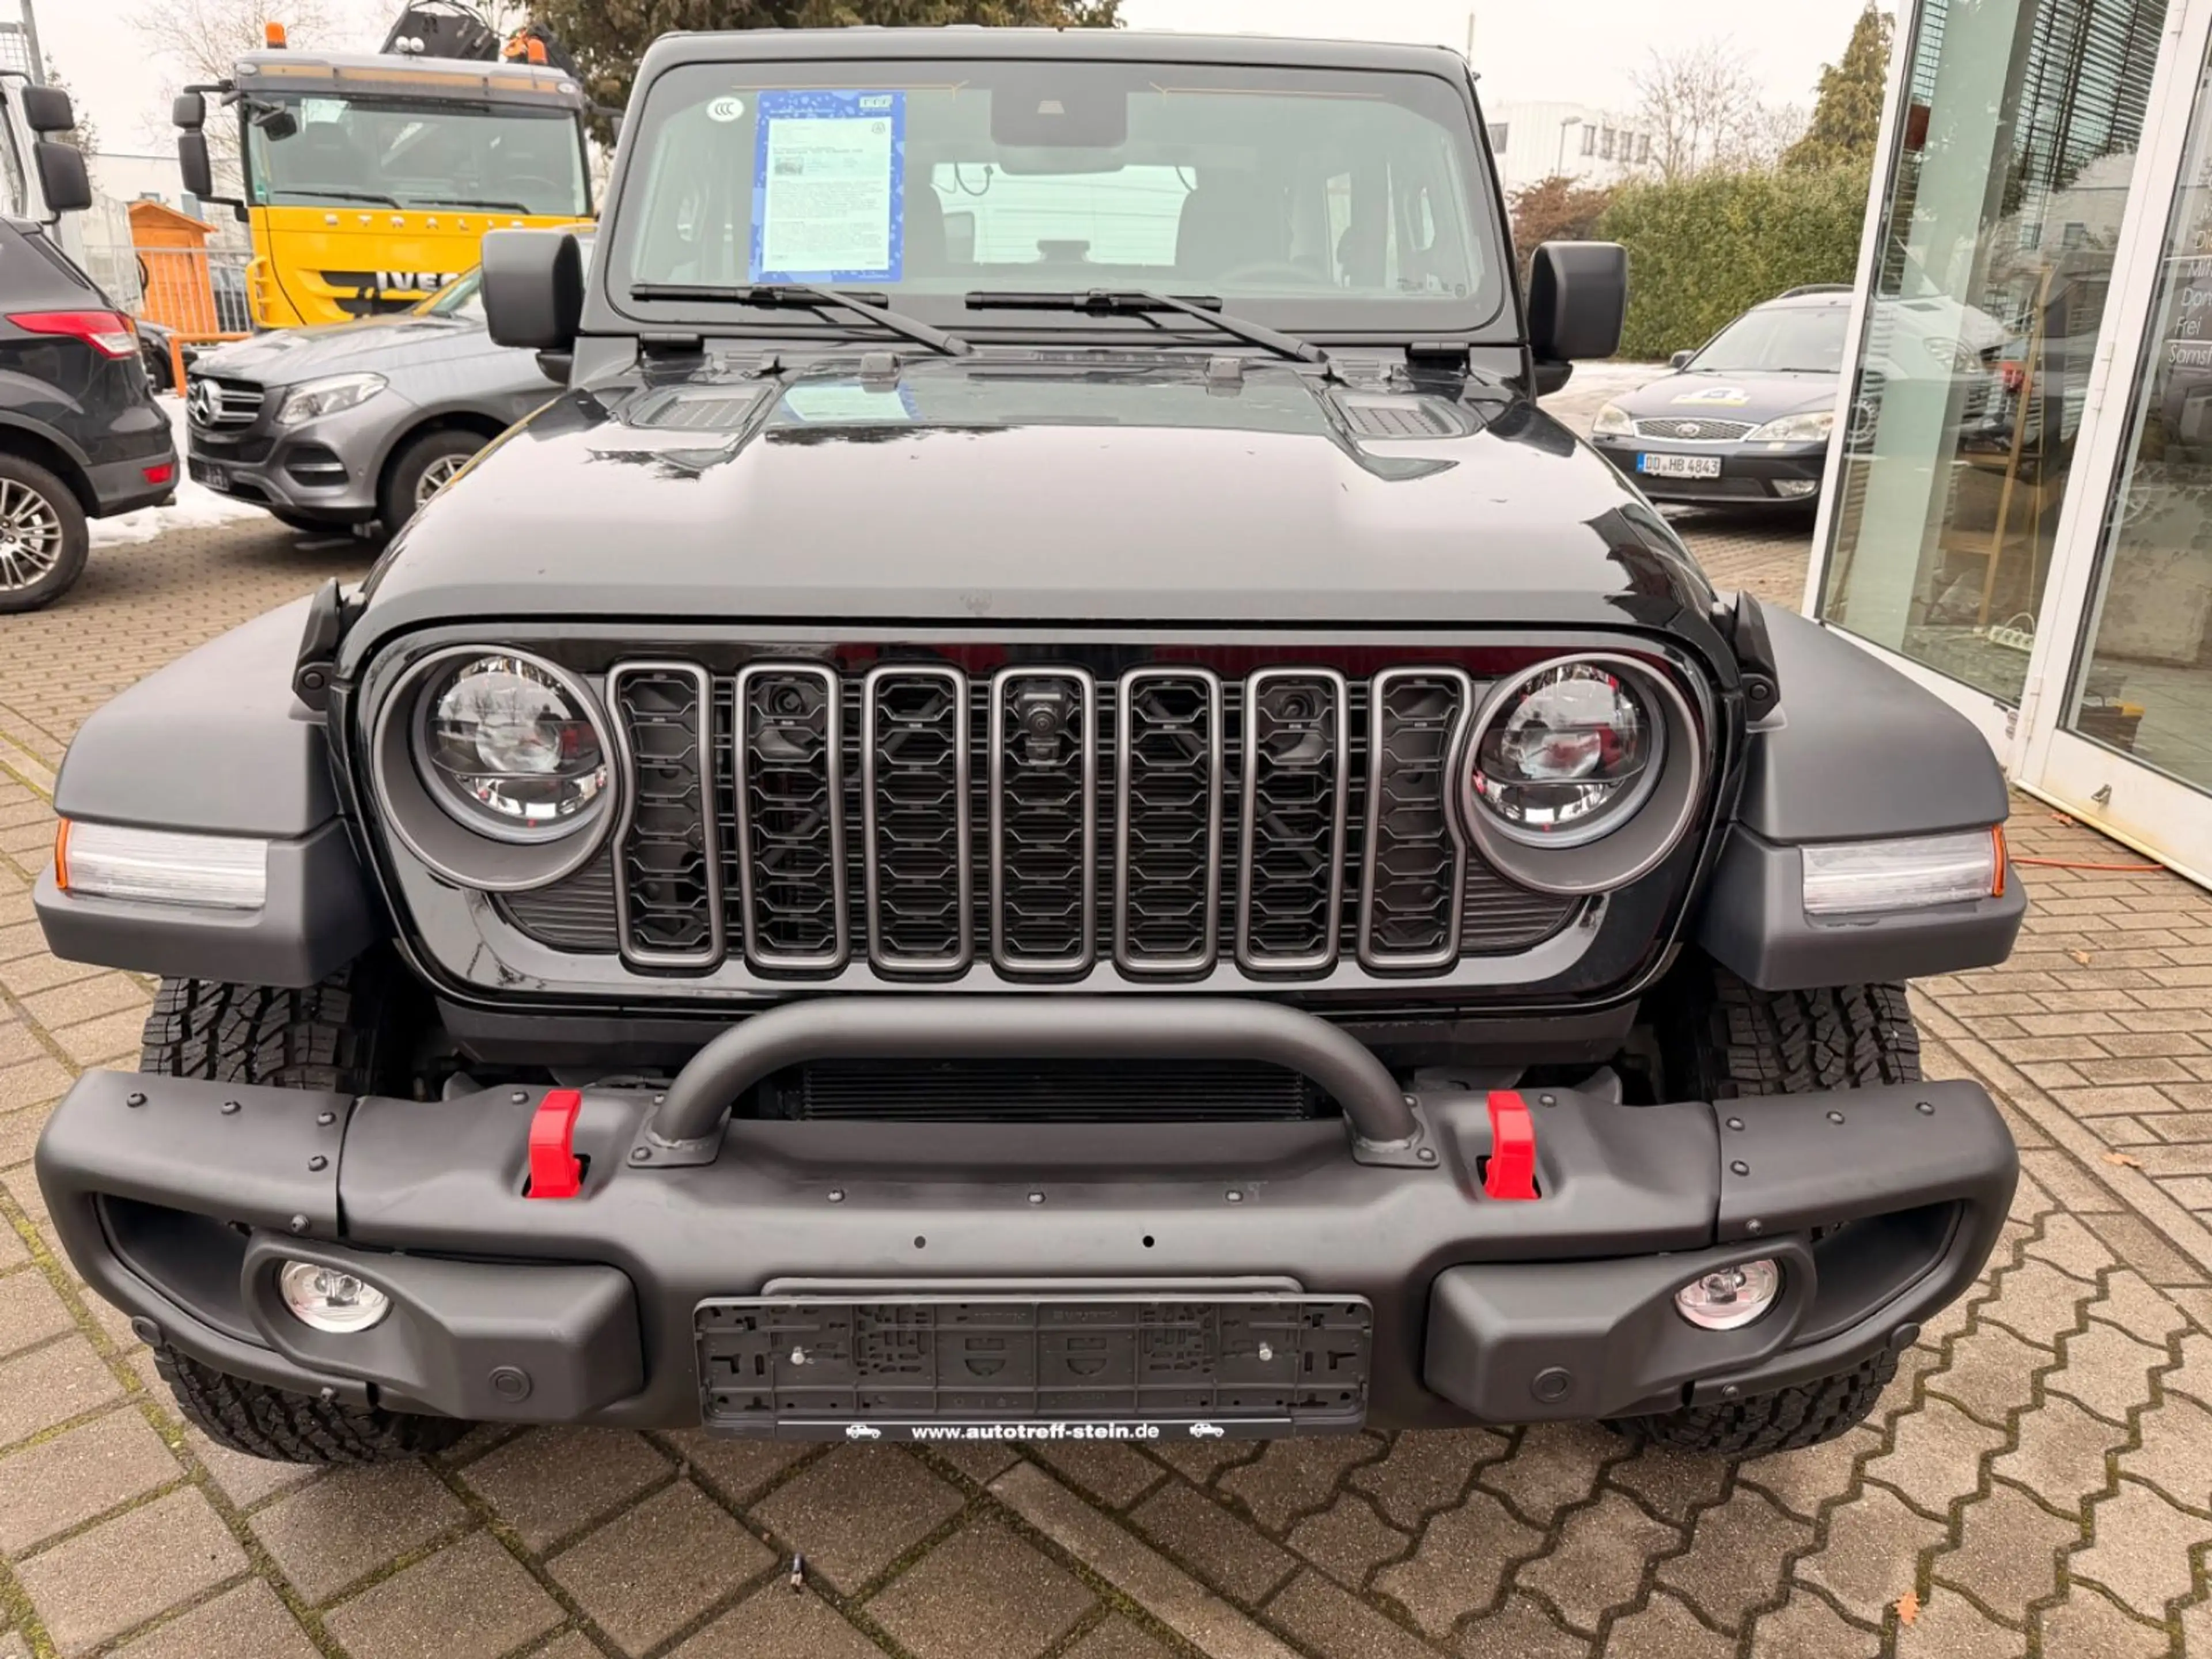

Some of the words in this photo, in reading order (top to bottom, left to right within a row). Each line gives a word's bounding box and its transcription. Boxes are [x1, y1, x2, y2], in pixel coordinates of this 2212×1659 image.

[2175, 316, 2202, 335] Frei
[1688, 459, 1718, 474] 4843
[911, 1423, 1160, 1439] www.autotreff-stein.de
